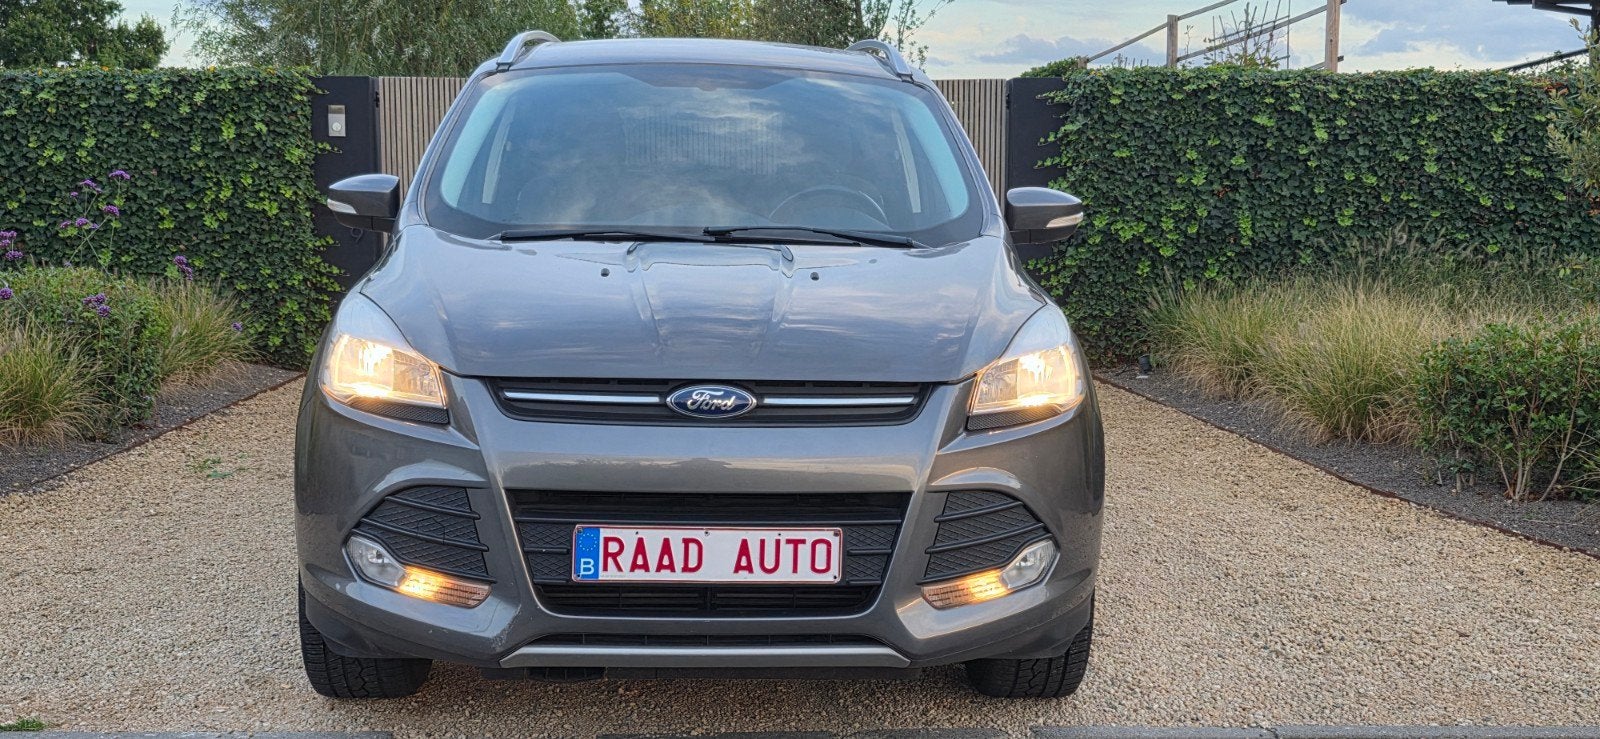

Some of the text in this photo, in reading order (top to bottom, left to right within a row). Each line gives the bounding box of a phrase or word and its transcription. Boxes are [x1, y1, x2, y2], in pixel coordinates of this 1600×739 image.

[686, 389, 737, 411] Ford
[580, 558, 595, 575] B
[602, 536, 832, 575] RAAD AUTO
